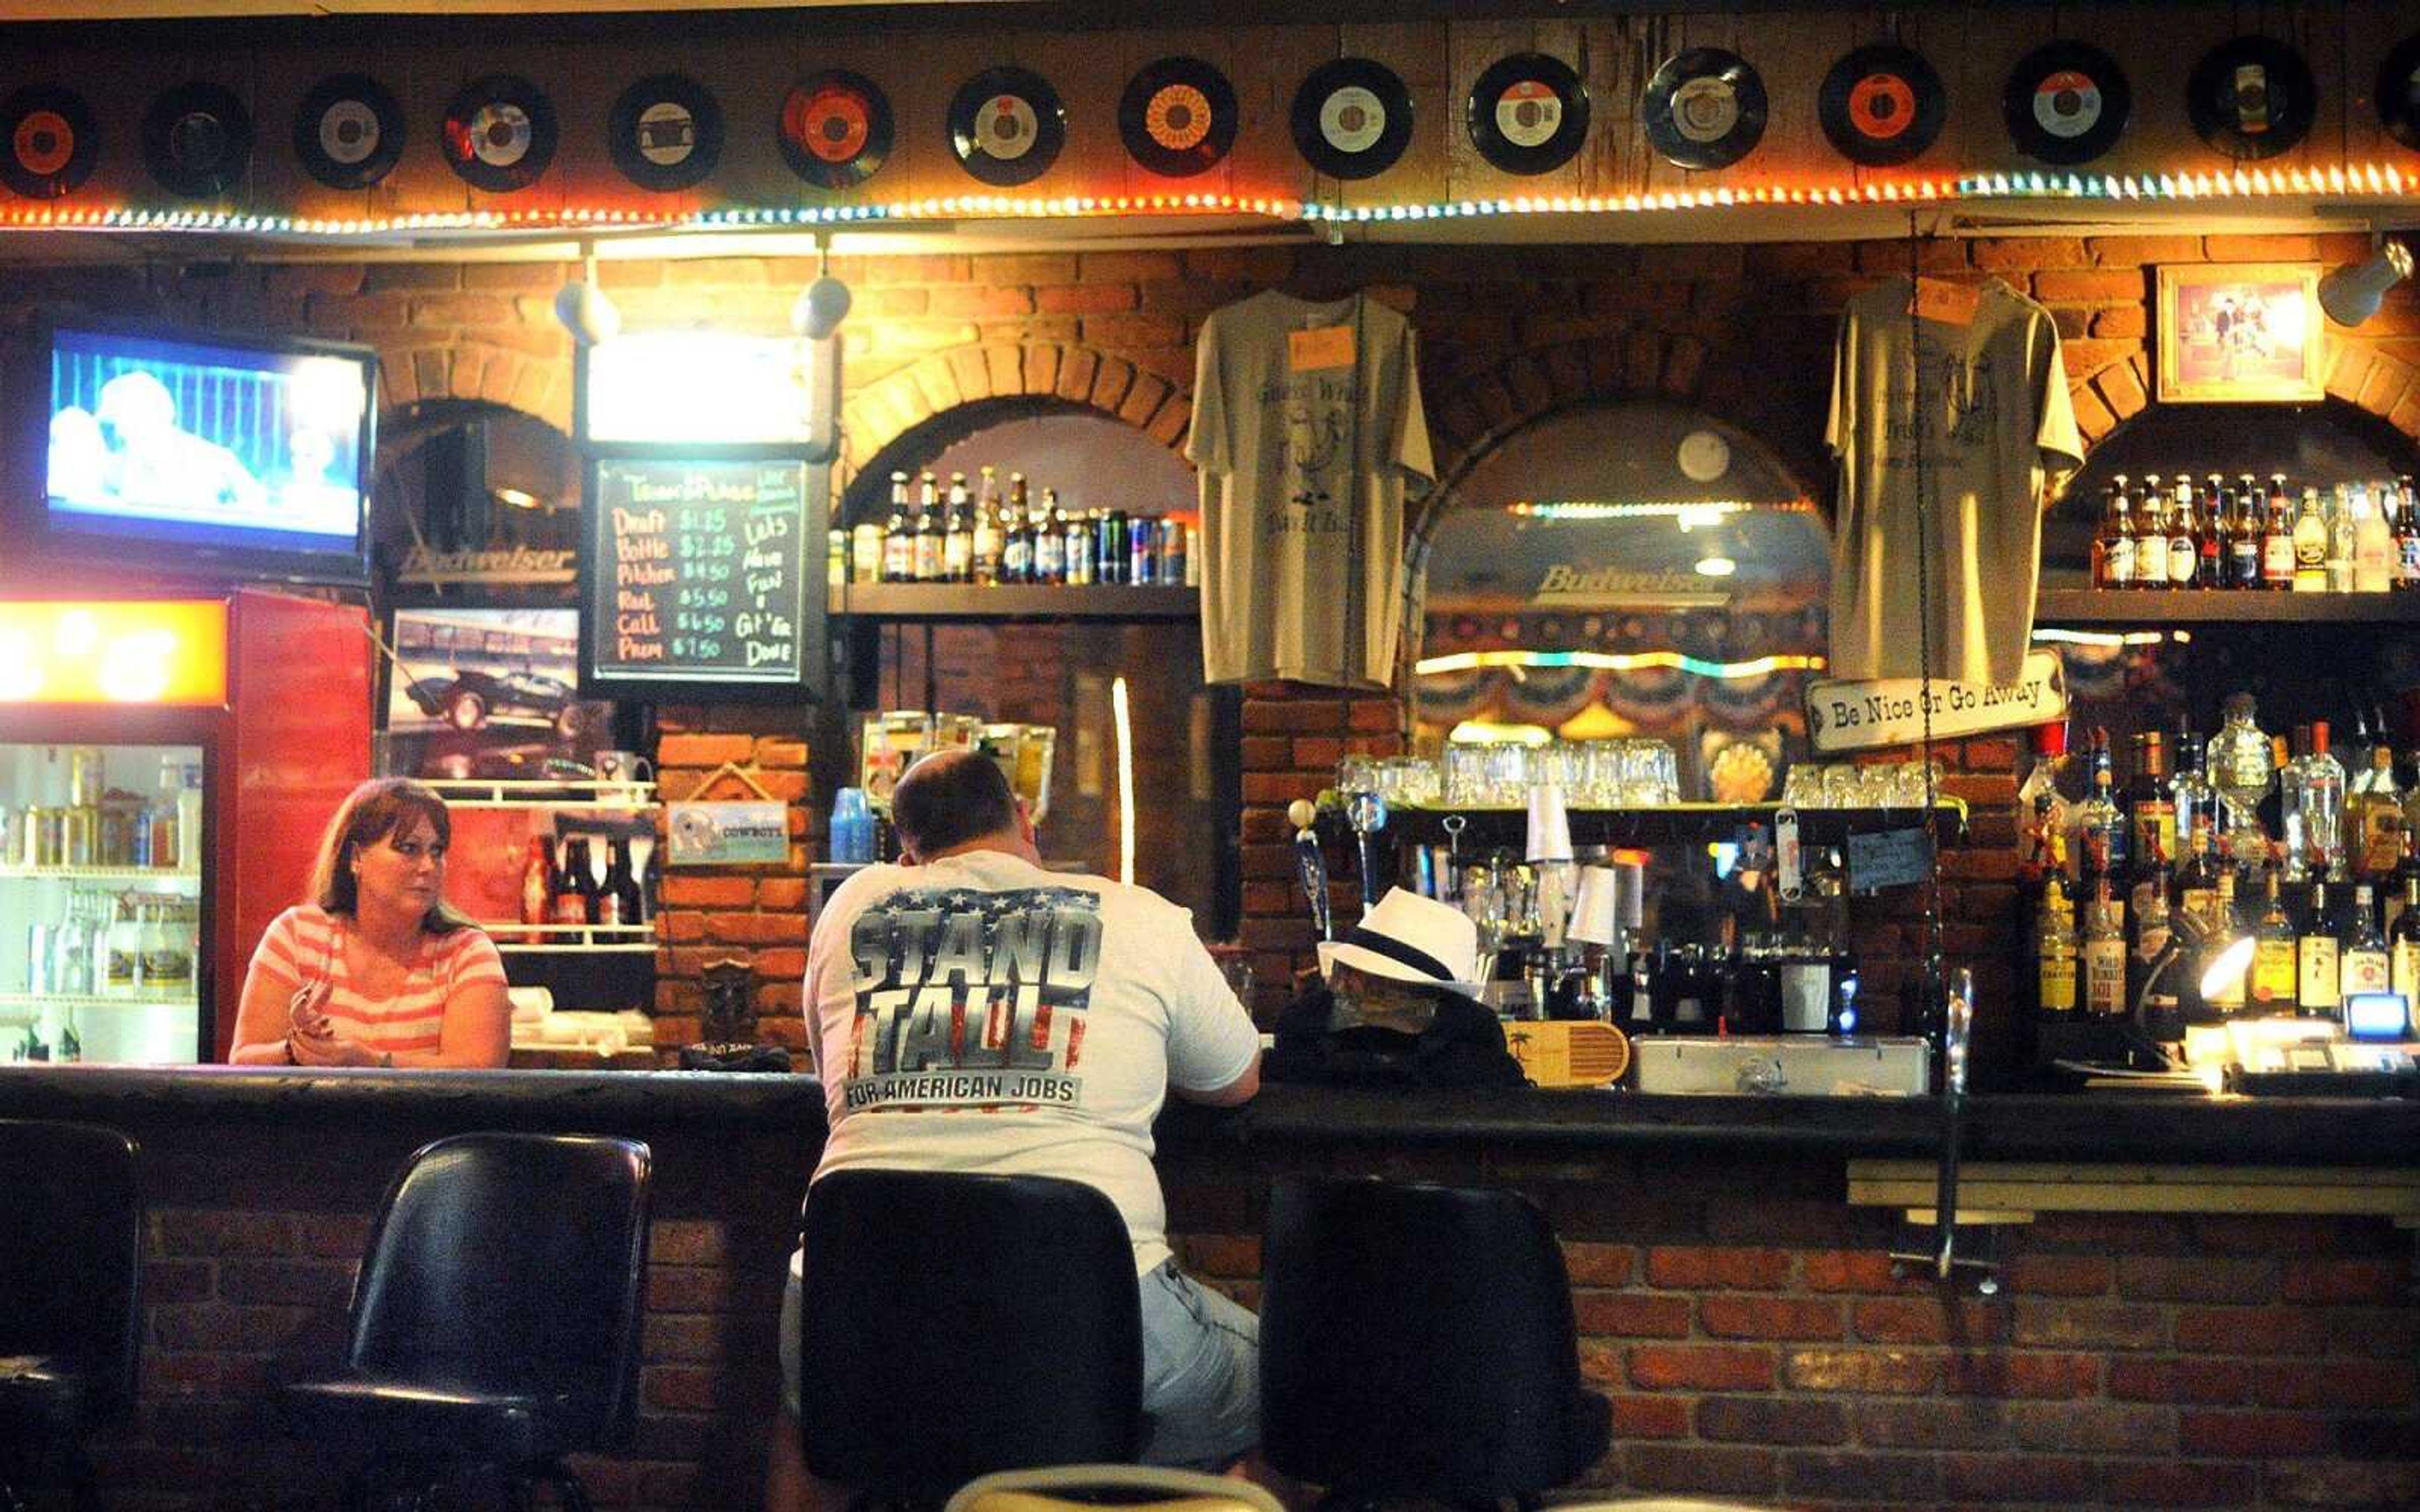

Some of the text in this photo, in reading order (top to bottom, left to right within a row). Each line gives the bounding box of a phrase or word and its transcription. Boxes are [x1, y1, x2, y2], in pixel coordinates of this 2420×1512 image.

[400, 543, 576, 570] Budweiser
[617, 536, 670, 561] Bottle
[1536, 563, 1718, 592] Budweiser
[1832, 700, 1860, 729] Be
[1867, 695, 1913, 724] Nice
[1950, 685, 1975, 711] Go
[1983, 679, 2041, 709] Away
[851, 908, 1103, 993] STAND
[869, 987, 1053, 1074] TALL
[846, 1075, 1073, 1108] FOR AMERICAN JOBS
